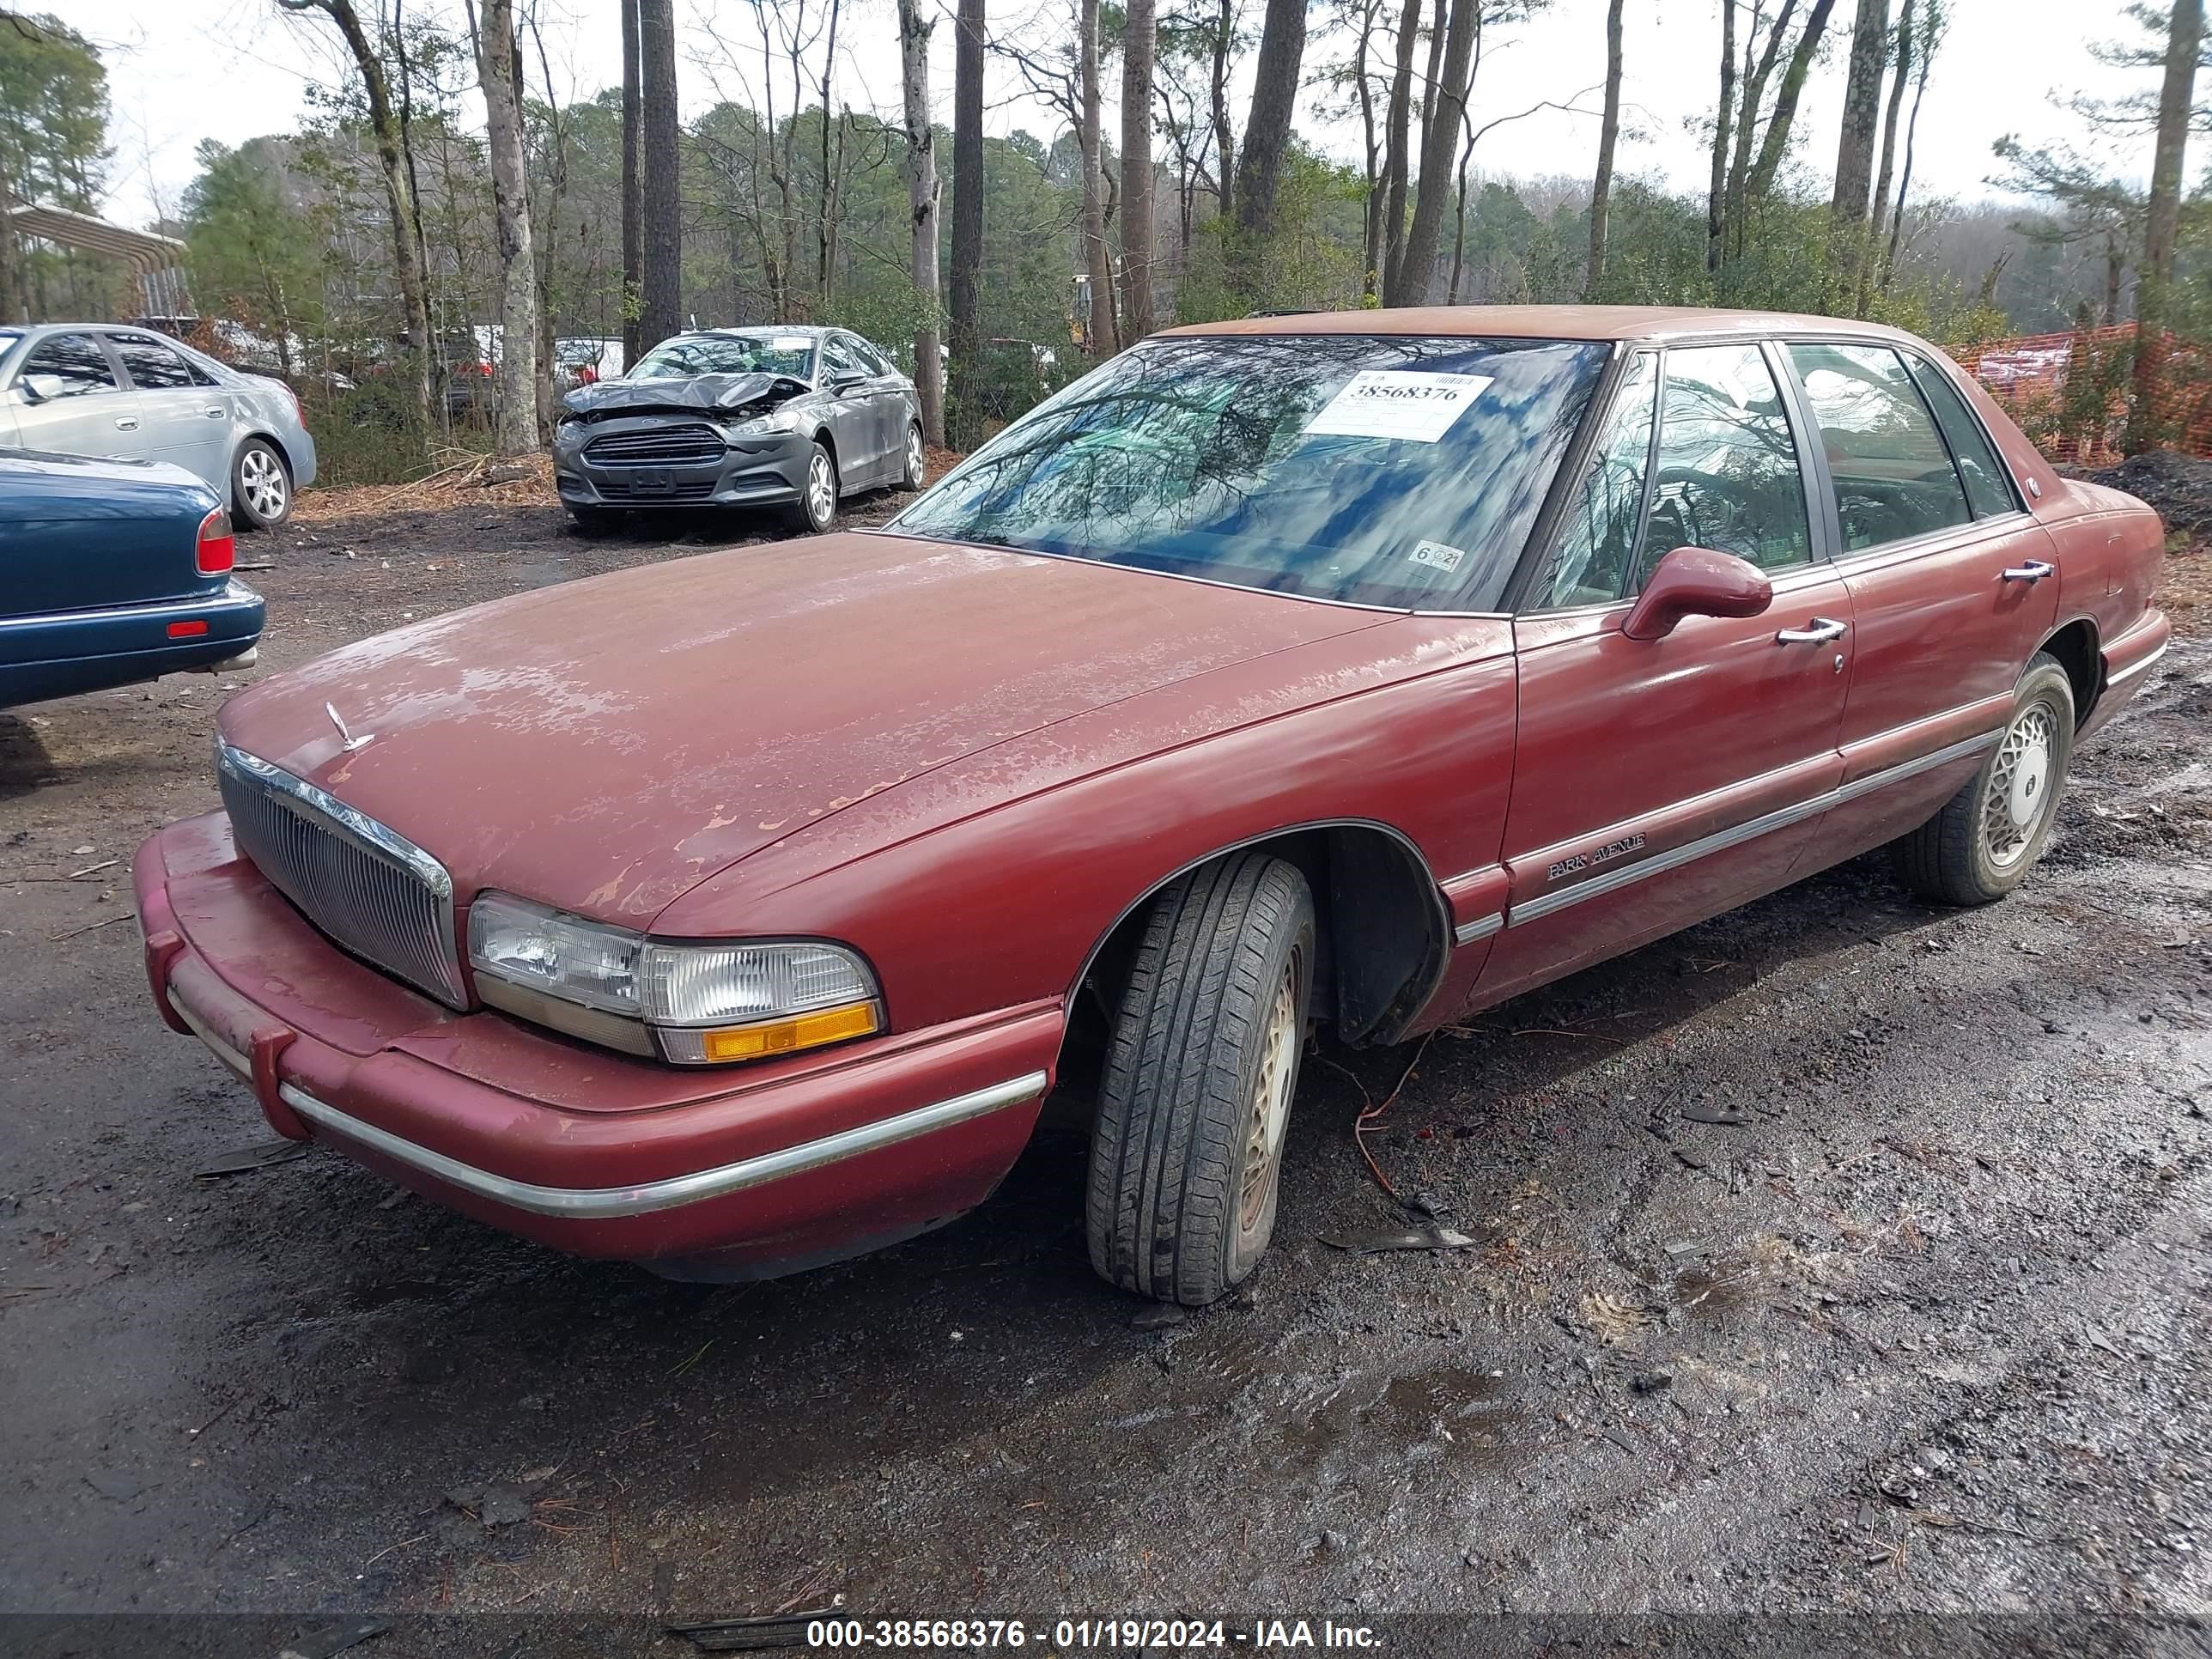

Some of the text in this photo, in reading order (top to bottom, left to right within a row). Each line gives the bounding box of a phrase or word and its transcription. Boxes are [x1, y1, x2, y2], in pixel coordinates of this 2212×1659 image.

[1350, 386, 1462, 401] 38568376
[1417, 547, 1459, 565] 6 21
[1548, 834, 1645, 879] PARK AVENUE
